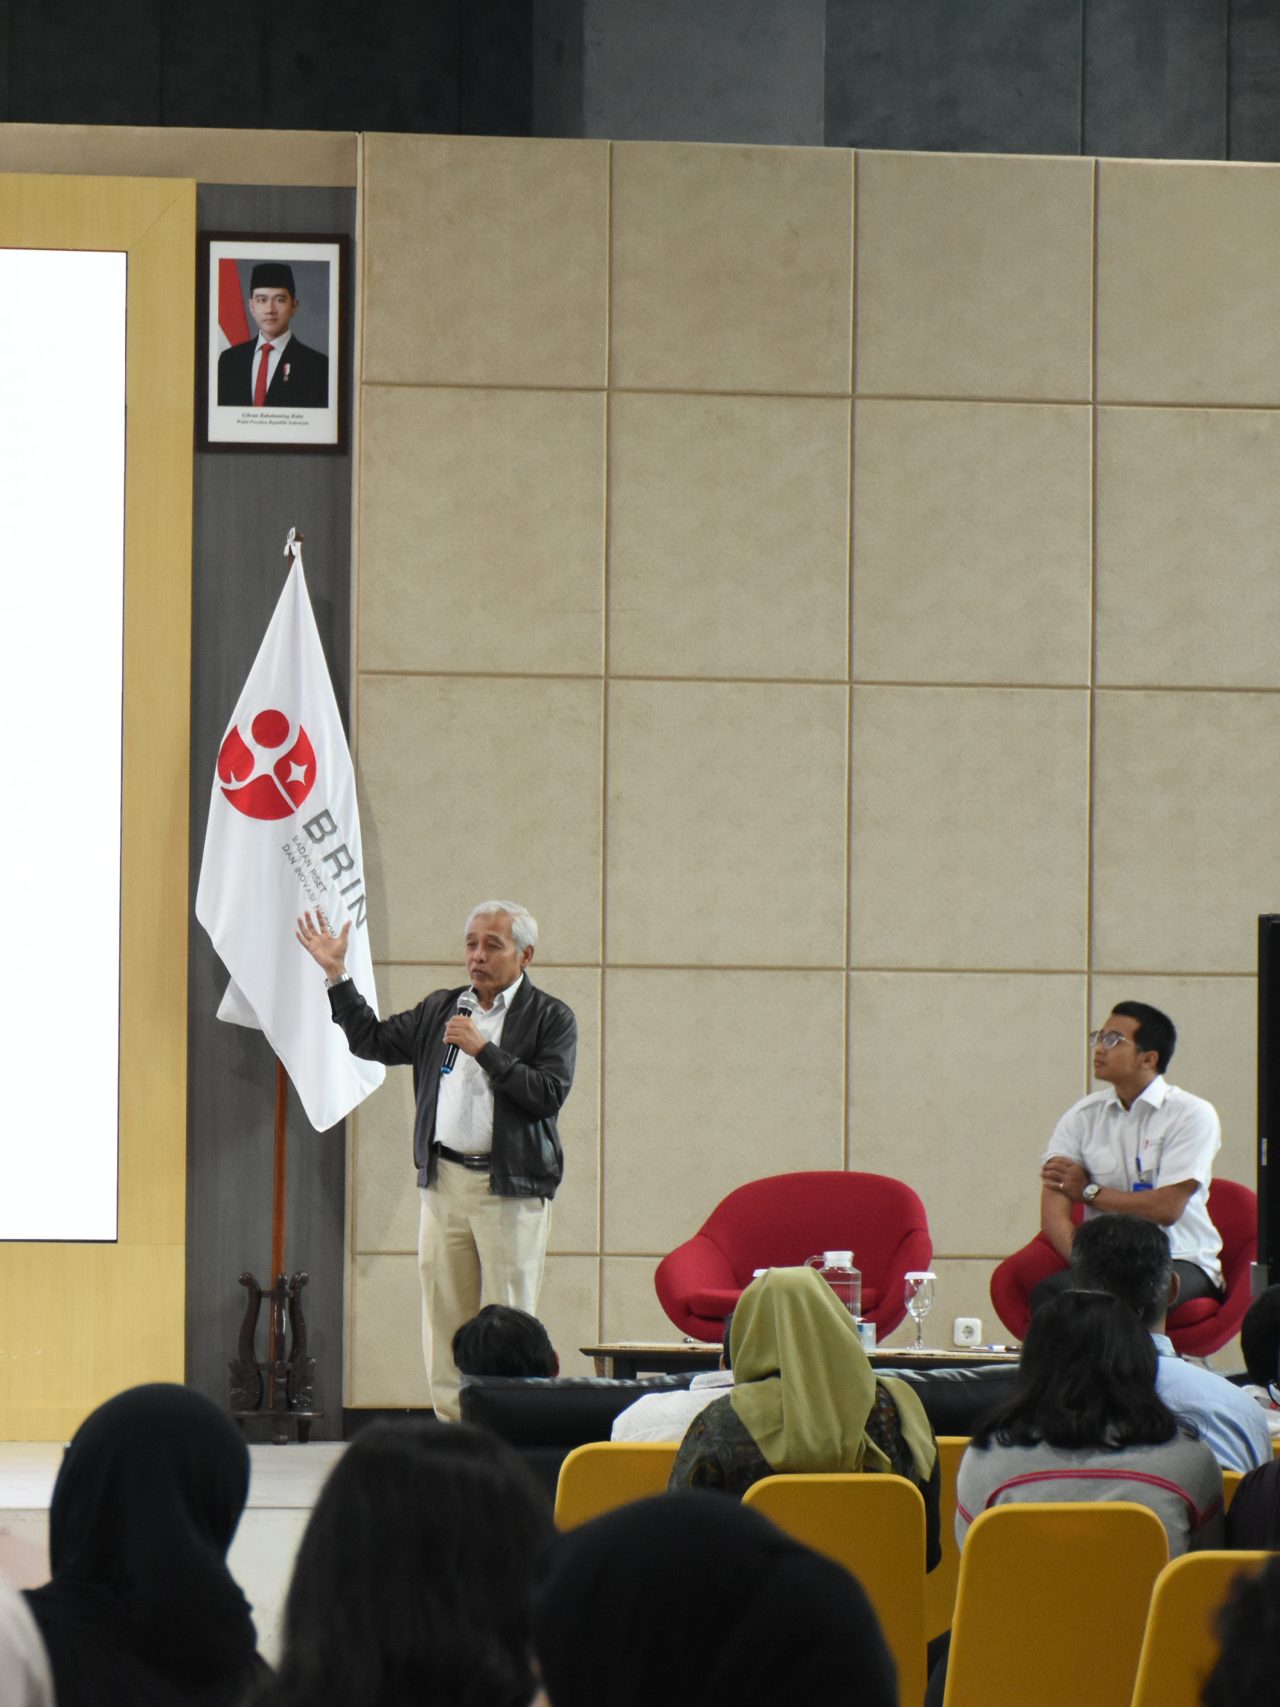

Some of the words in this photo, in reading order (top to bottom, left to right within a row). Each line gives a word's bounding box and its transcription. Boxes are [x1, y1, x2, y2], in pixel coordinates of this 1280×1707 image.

[282, 844, 298, 865] DAN
[292, 835, 313, 867] BADAN
[310, 868, 327, 893] RISET
[302, 808, 367, 931] BRIN
